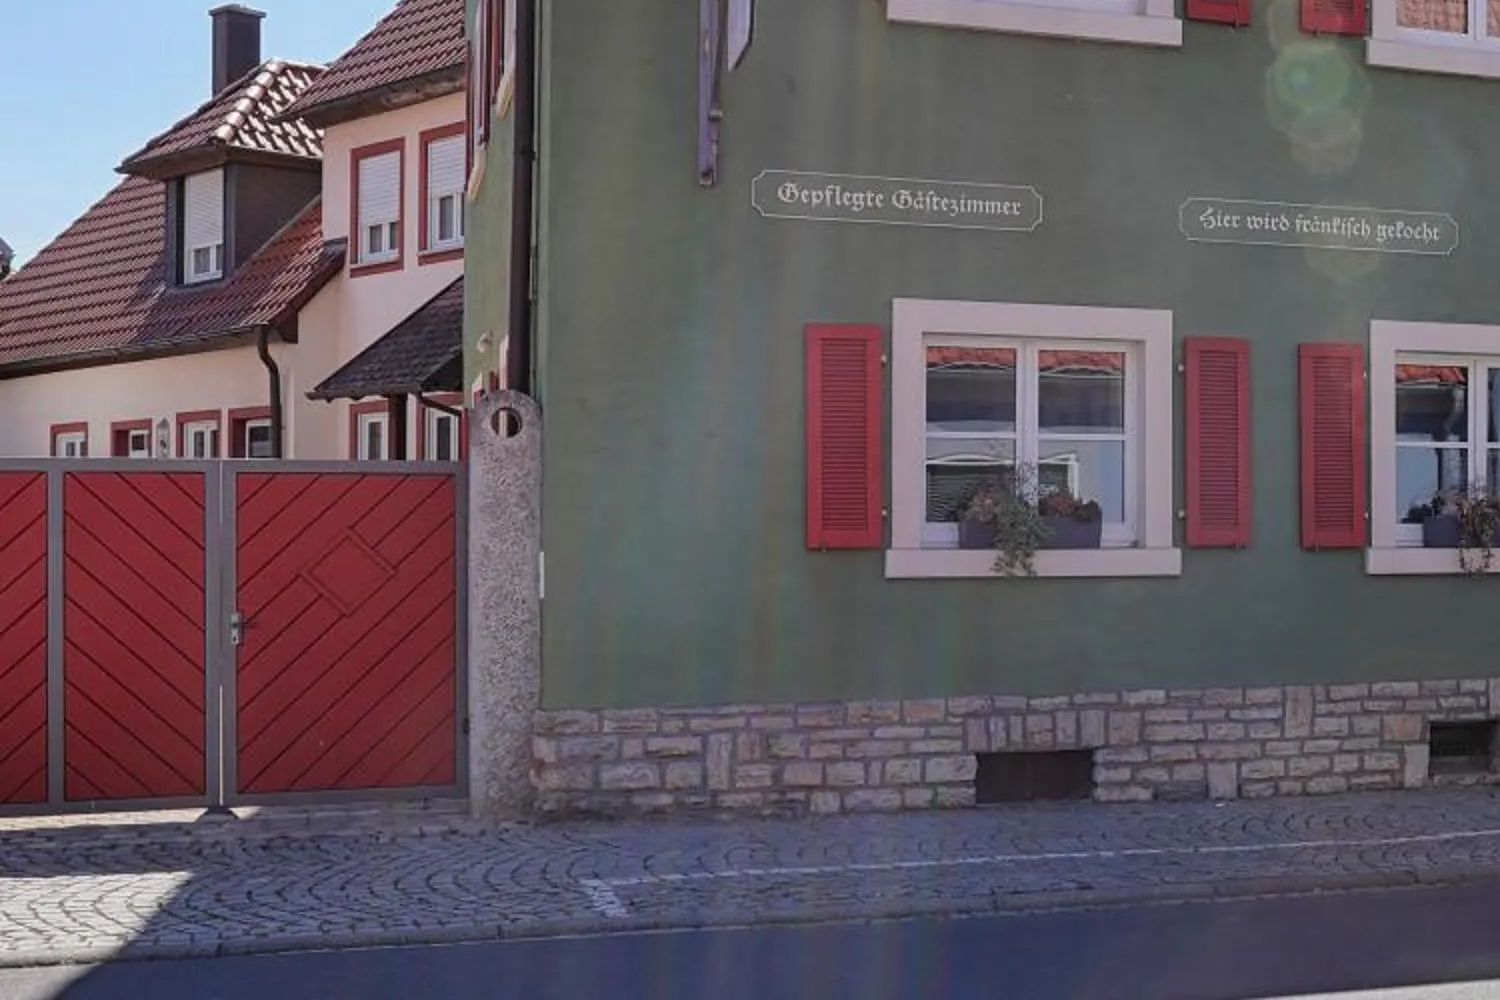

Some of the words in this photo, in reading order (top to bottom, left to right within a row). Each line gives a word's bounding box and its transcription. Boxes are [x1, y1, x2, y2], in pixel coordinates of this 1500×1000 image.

[777, 182, 884, 211] Gepflegte
[892, 189, 1022, 217] Gästezimmer
[1199, 205, 1241, 230] Hier
[1247, 213, 1291, 232] wird
[1376, 219, 1440, 243] gekocht
